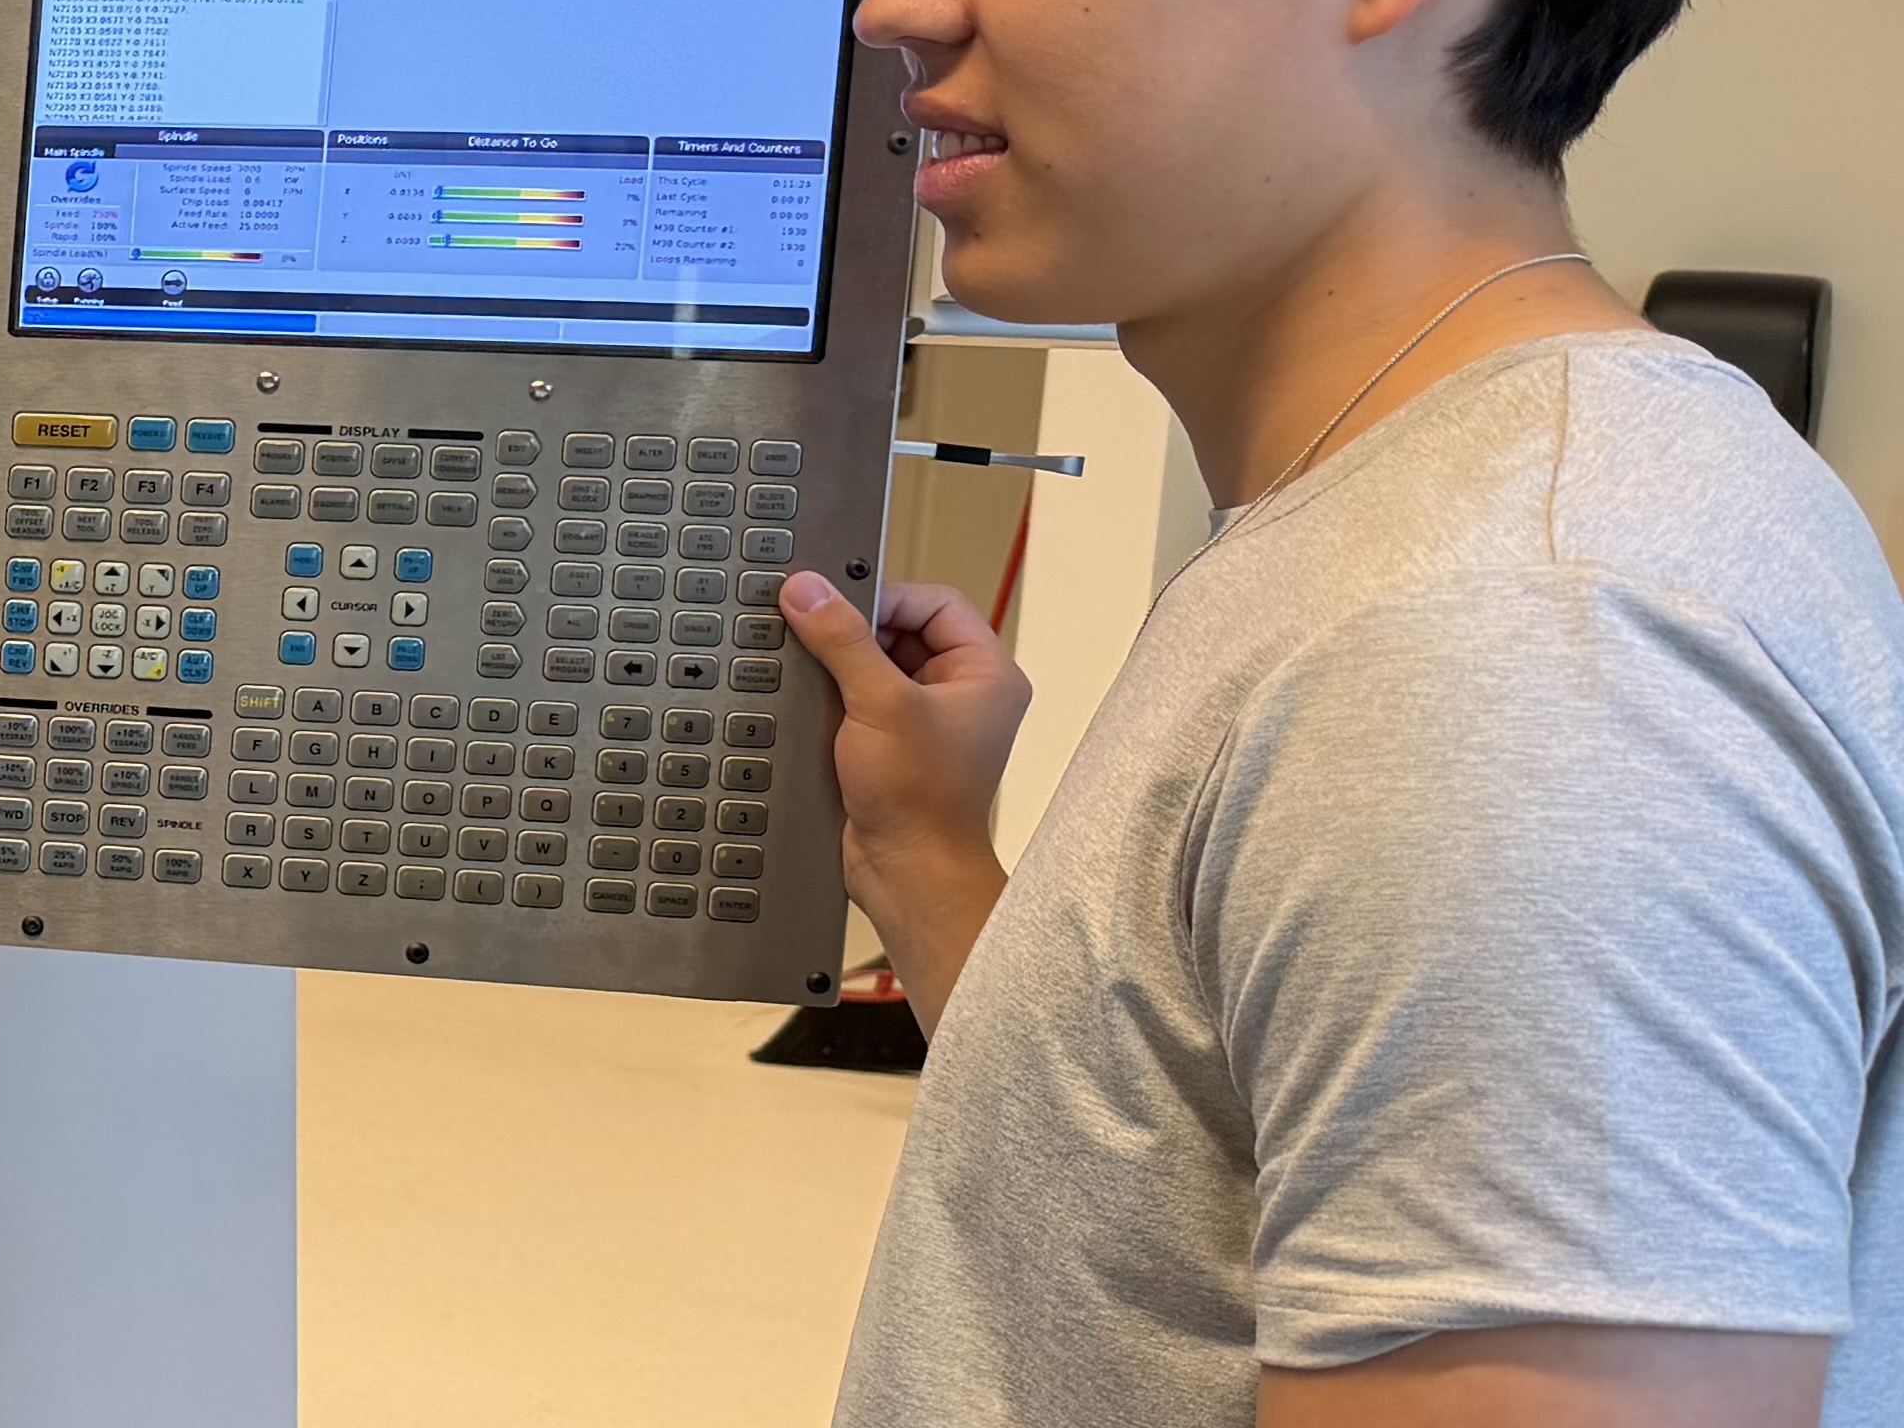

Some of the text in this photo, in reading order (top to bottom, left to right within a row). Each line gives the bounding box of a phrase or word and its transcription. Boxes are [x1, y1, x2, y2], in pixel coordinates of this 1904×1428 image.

[158, 131, 198, 143] Spindle
[338, 134, 388, 145] Positions
[468, 136, 557, 149] Distance To Go
[678, 140, 802, 154] Timers And Counters
[38, 424, 91, 437] RESET
[340, 426, 401, 438] DISPLAY
[24, 477, 40, 489] F1
[80, 479, 98, 491] F2
[138, 481, 156, 493] F3
[196, 483, 214, 495] F4
[331, 602, 377, 612] CURSOR
[99, 610, 119, 619] JOG
[95, 623, 122, 632] LOCK
[240, 695, 280, 709] SHIFT
[312, 700, 324, 713] A
[65, 701, 140, 716] OVERRIDES
[372, 703, 382, 716] B
[430, 706, 442, 719] C
[489, 710, 500, 722] D
[549, 713, 559, 725] E
[623, 717, 632, 729] 7
[684, 721, 693, 733] 8
[59, 725, 86, 735] 100%
[747, 725, 756, 736] 9
[253, 740, 262, 751] F
[310, 743, 321, 755] G
[368, 746, 379, 758] H
[430, 750, 434, 762] I
[487, 753, 496, 766] J
[544, 756, 556, 768] K
[57, 768, 83, 776] 100%
[618, 761, 627, 772] 4
[681, 764, 690, 777] 5
[743, 768, 752, 780] 6
[250, 781, 258, 794] L
[306, 785, 318, 798] M
[365, 789, 376, 801] N
[423, 792, 434, 805] O
[483, 796, 492, 808] P
[541, 799, 553, 812] Q
[618, 805, 623, 816] 1
[676, 808, 685, 820] 2
[50, 813, 84, 823] STOP
[111, 817, 136, 827] REV
[739, 812, 748, 824] 3
[157, 819, 202, 830] SPINDLE
[246, 824, 256, 836] R
[304, 827, 314, 840] S
[362, 832, 373, 843] T
[420, 835, 430, 848] U
[479, 839, 489, 851] V
[536, 843, 551, 855] W
[673, 852, 681, 863] 0
[242, 867, 253, 878] X
[301, 870, 310, 882] Y
[359, 874, 369, 886] Z
[593, 891, 631, 902] CANCEL
[658, 896, 689, 906] SPACE
[719, 901, 752, 910] ENTER
